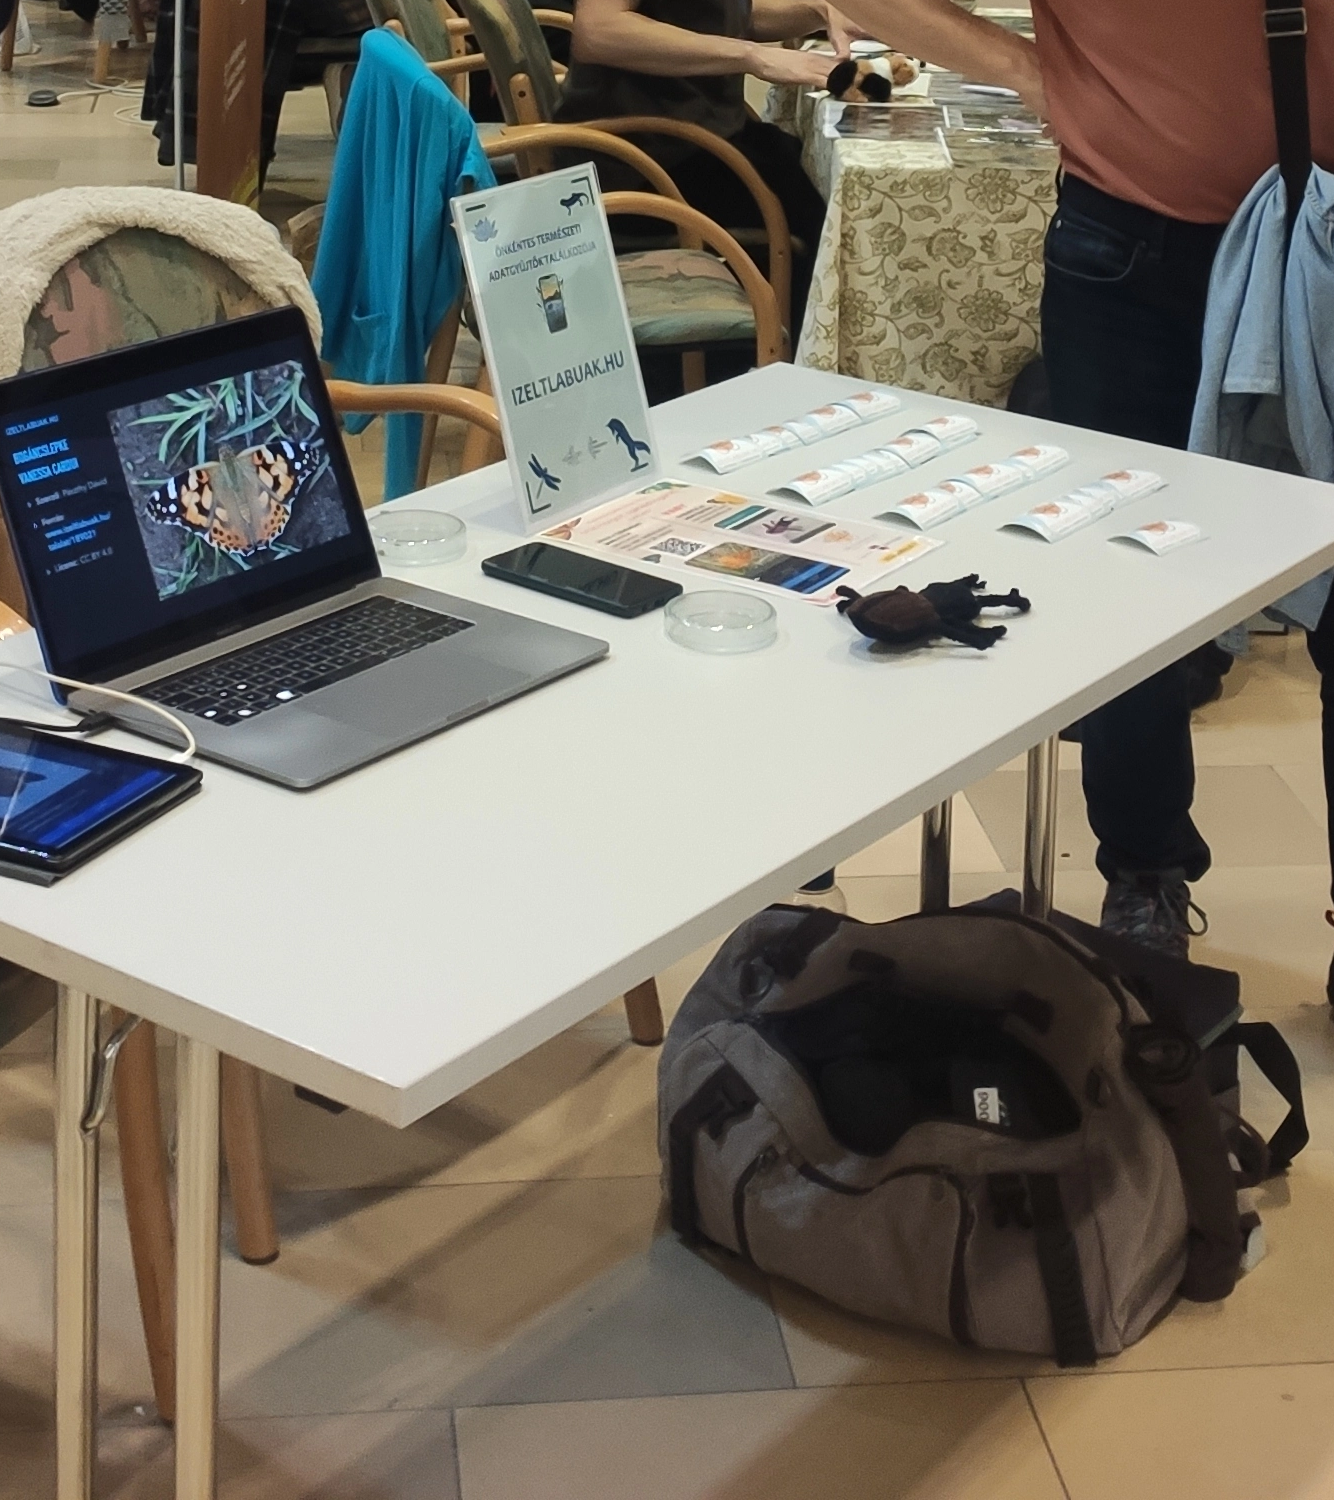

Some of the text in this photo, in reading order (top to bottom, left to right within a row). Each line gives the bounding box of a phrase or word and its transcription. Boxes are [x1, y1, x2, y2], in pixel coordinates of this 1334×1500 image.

[494, 223, 582, 258] ÖNKÉNTES TERMÉSZETI
[511, 350, 625, 406] IZELTLABUAK.HU
